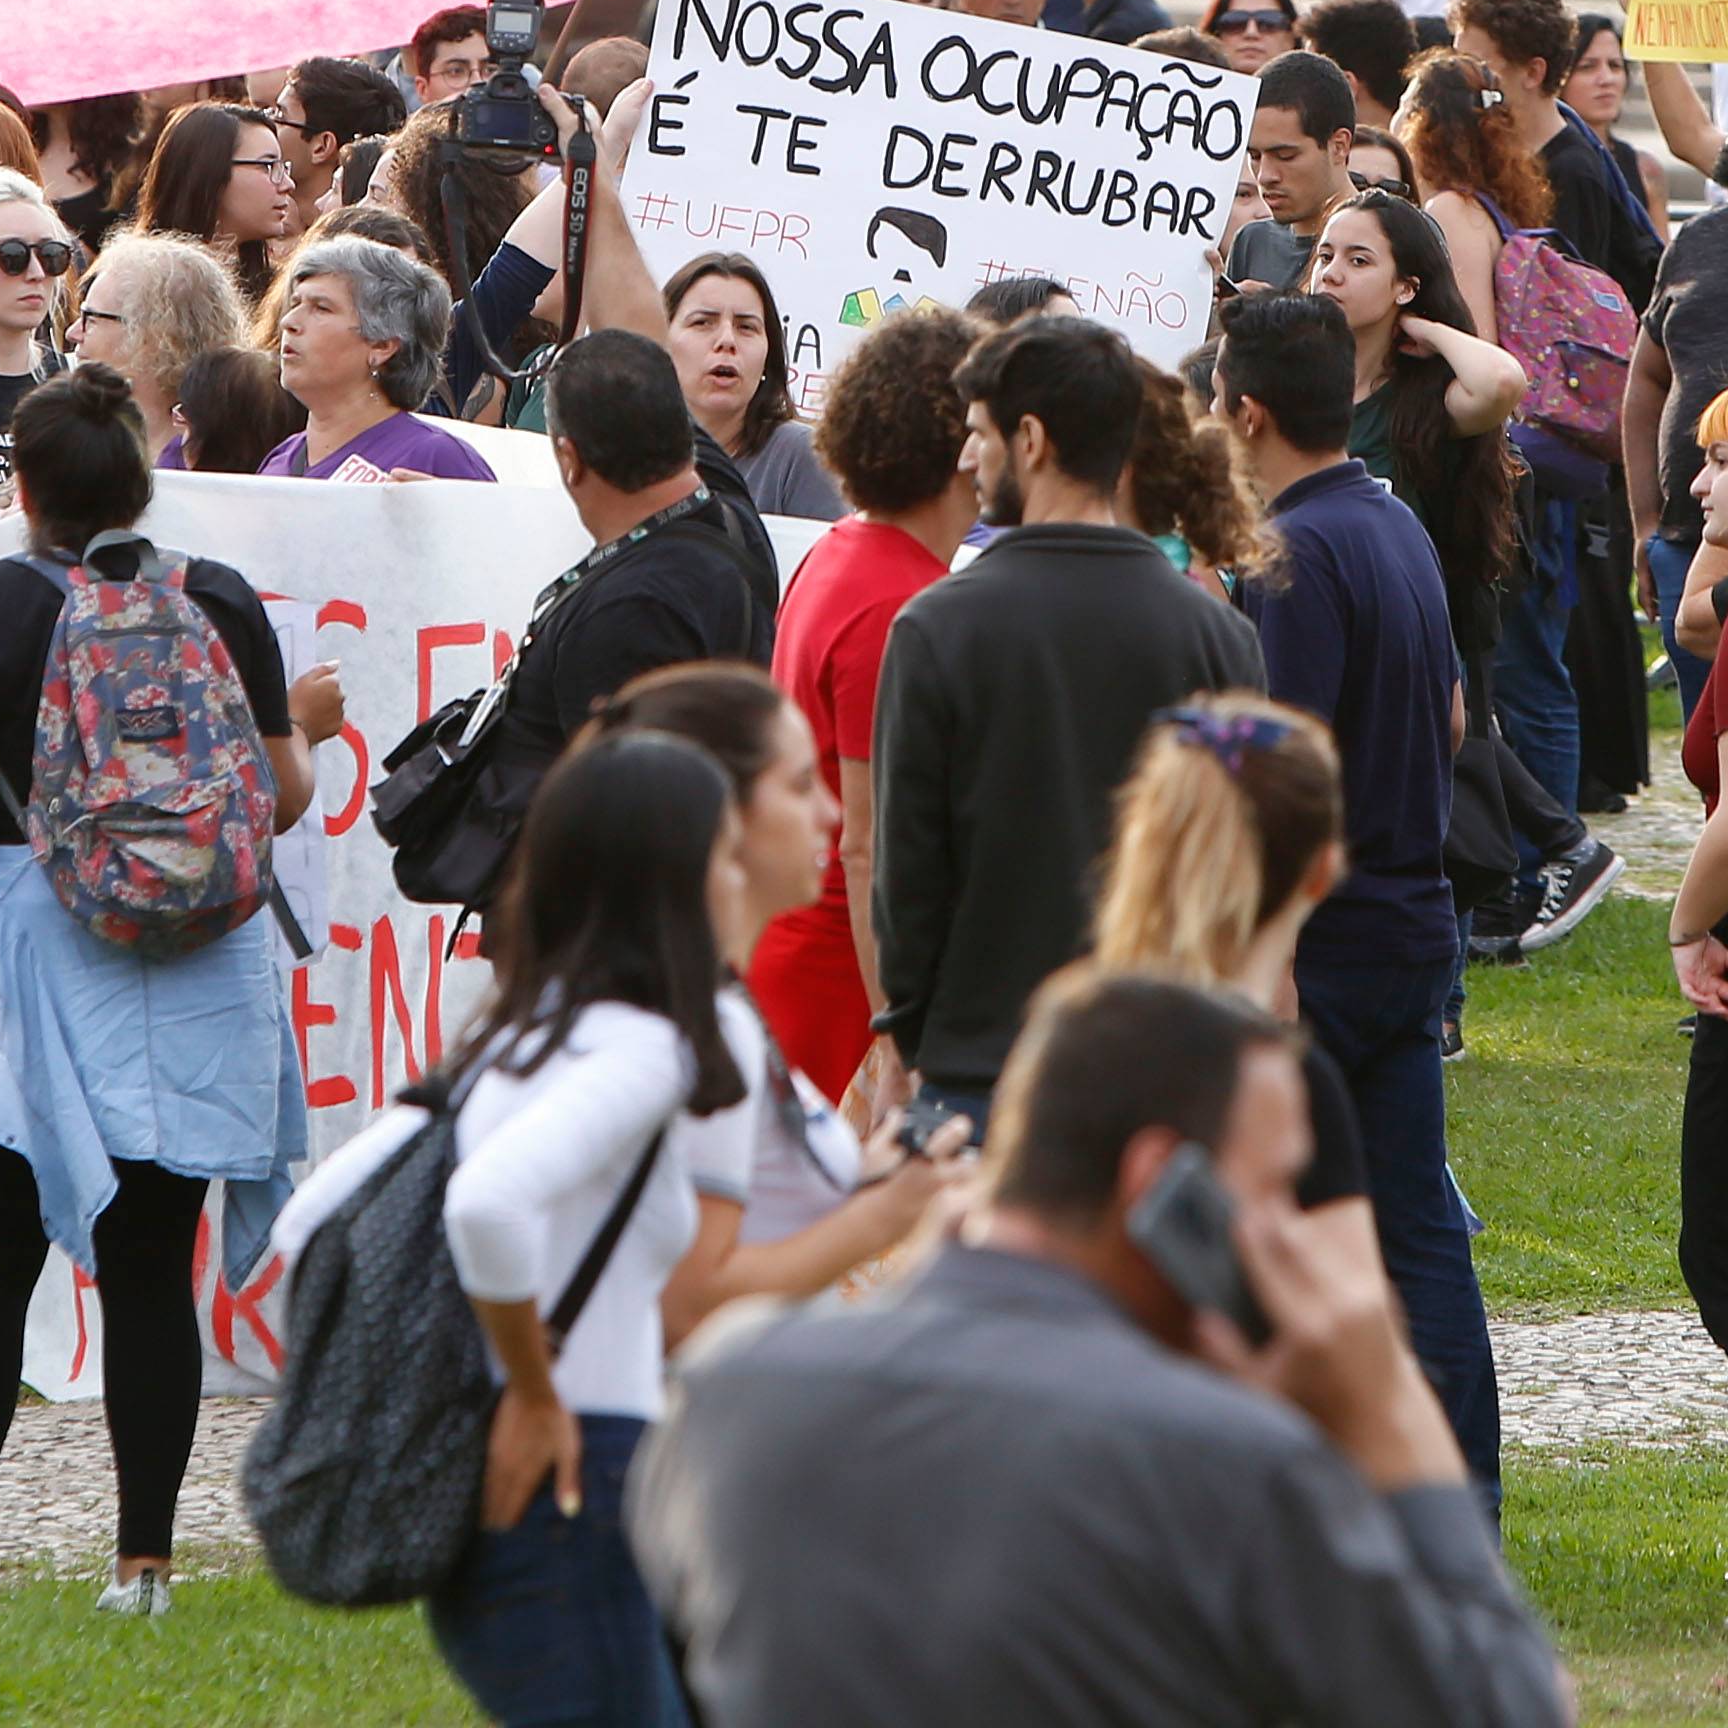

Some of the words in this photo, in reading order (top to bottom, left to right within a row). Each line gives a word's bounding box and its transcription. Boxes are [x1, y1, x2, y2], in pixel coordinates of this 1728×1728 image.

[919, 35, 1242, 162] OCUPAÇÃO
[572, 167, 589, 209] EOS
[648, 70, 700, 156] É
[736, 103, 829, 176] TE
[882, 123, 1216, 241] DERRUBAR
[631, 191, 812, 261] #UFPR
